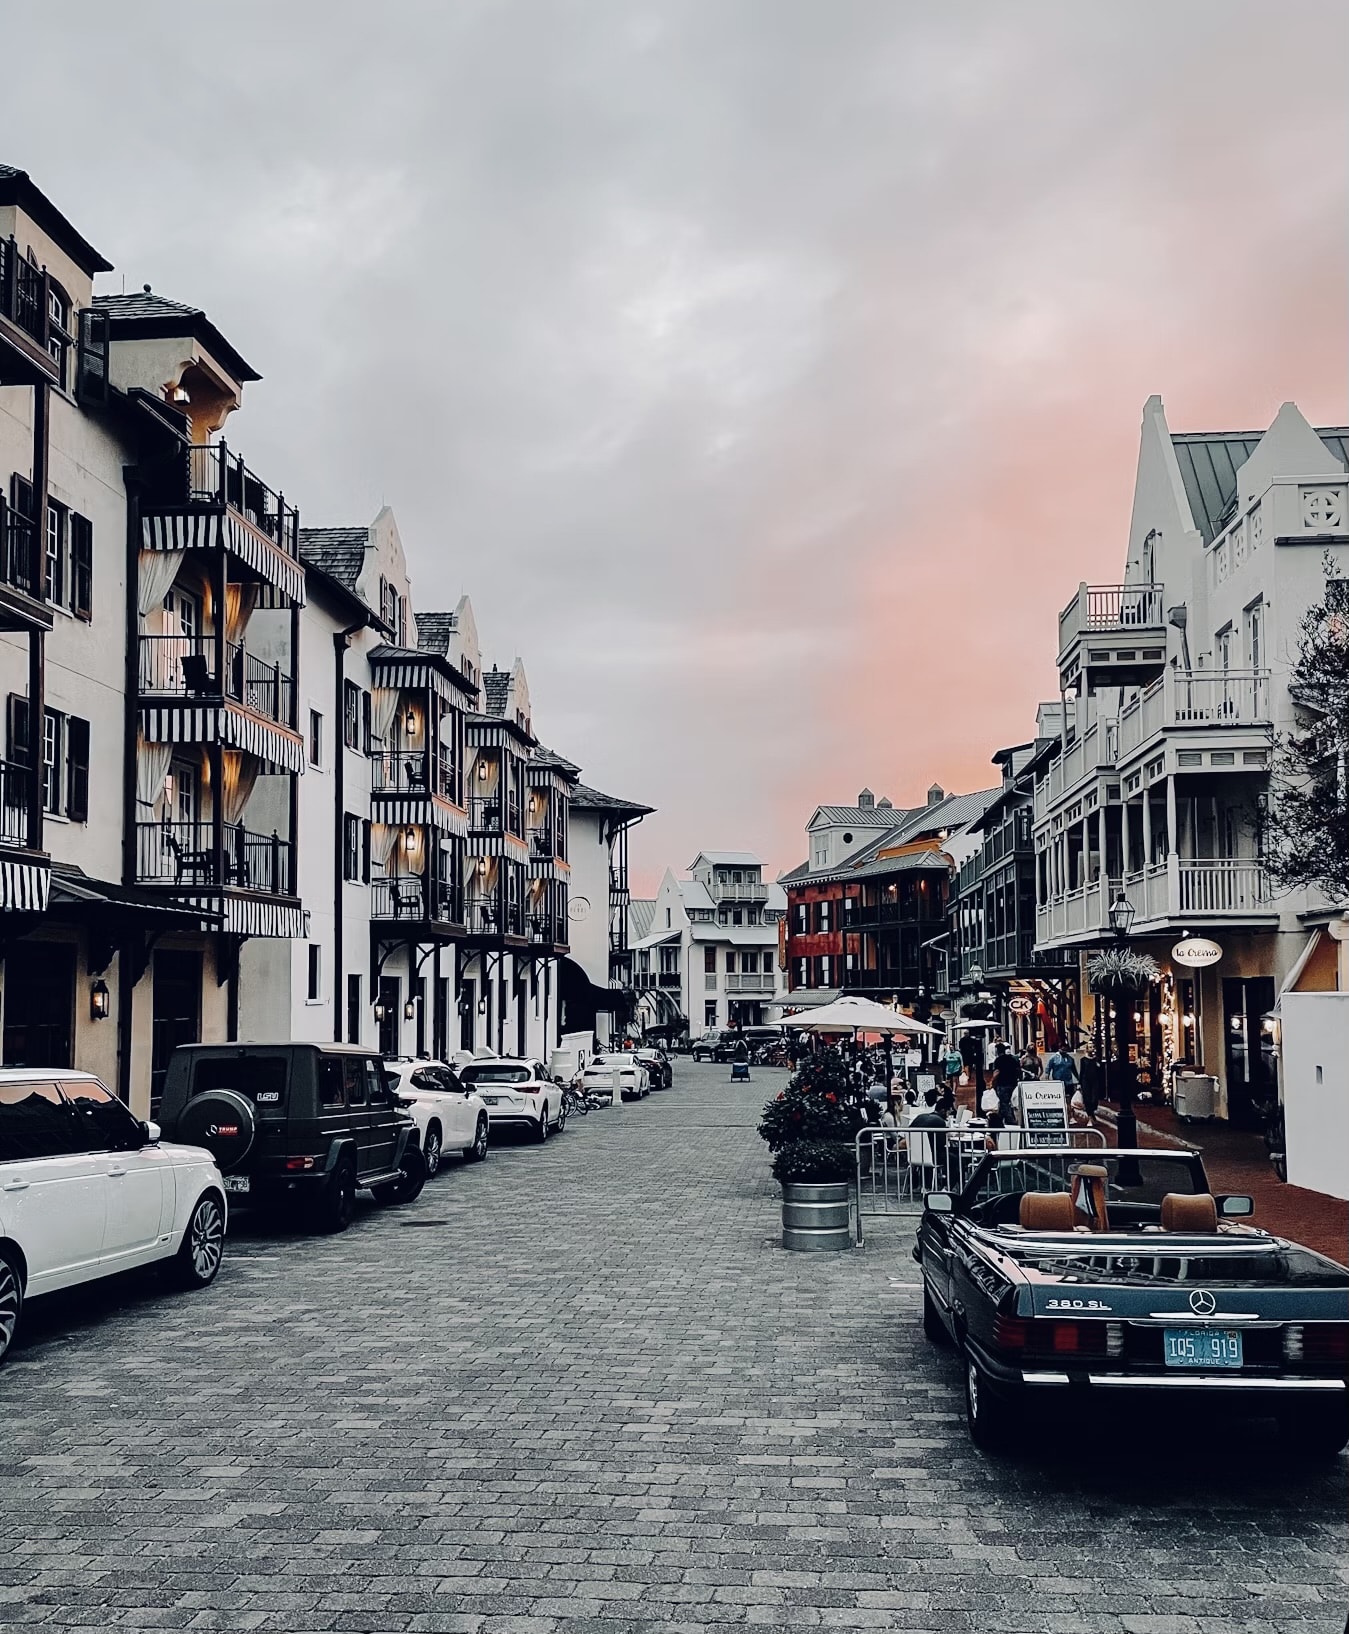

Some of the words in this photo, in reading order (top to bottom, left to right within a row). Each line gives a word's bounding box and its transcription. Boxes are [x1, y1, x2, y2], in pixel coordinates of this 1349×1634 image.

[1187, 948, 1218, 957] Crema
[1010, 1000, 1029, 1010] CK
[257, 1092, 279, 1101] LSU
[1035, 1091, 1062, 1100] Crema
[1048, 1299, 1084, 1308] 380
[1087, 1300, 1109, 1309] SL
[1169, 1337, 1195, 1357] IQ5
[1211, 1338, 1238, 1358] 919
